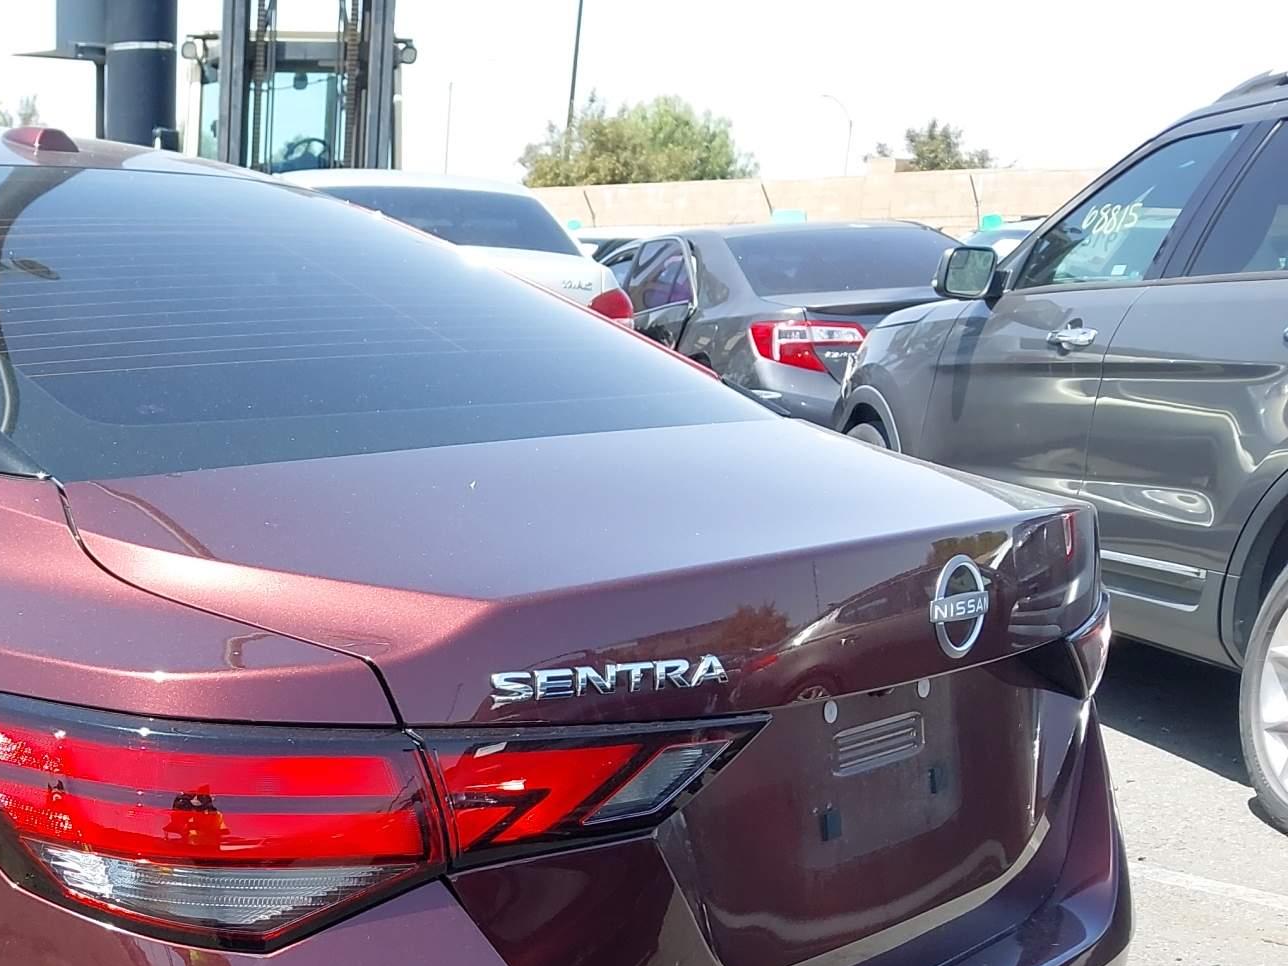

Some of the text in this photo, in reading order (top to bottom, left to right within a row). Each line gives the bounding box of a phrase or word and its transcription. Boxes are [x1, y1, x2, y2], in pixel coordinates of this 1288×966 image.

[1081, 203, 1144, 234] 68815
[934, 597, 988, 619] NISSAN
[490, 654, 728, 710] SENTRA
